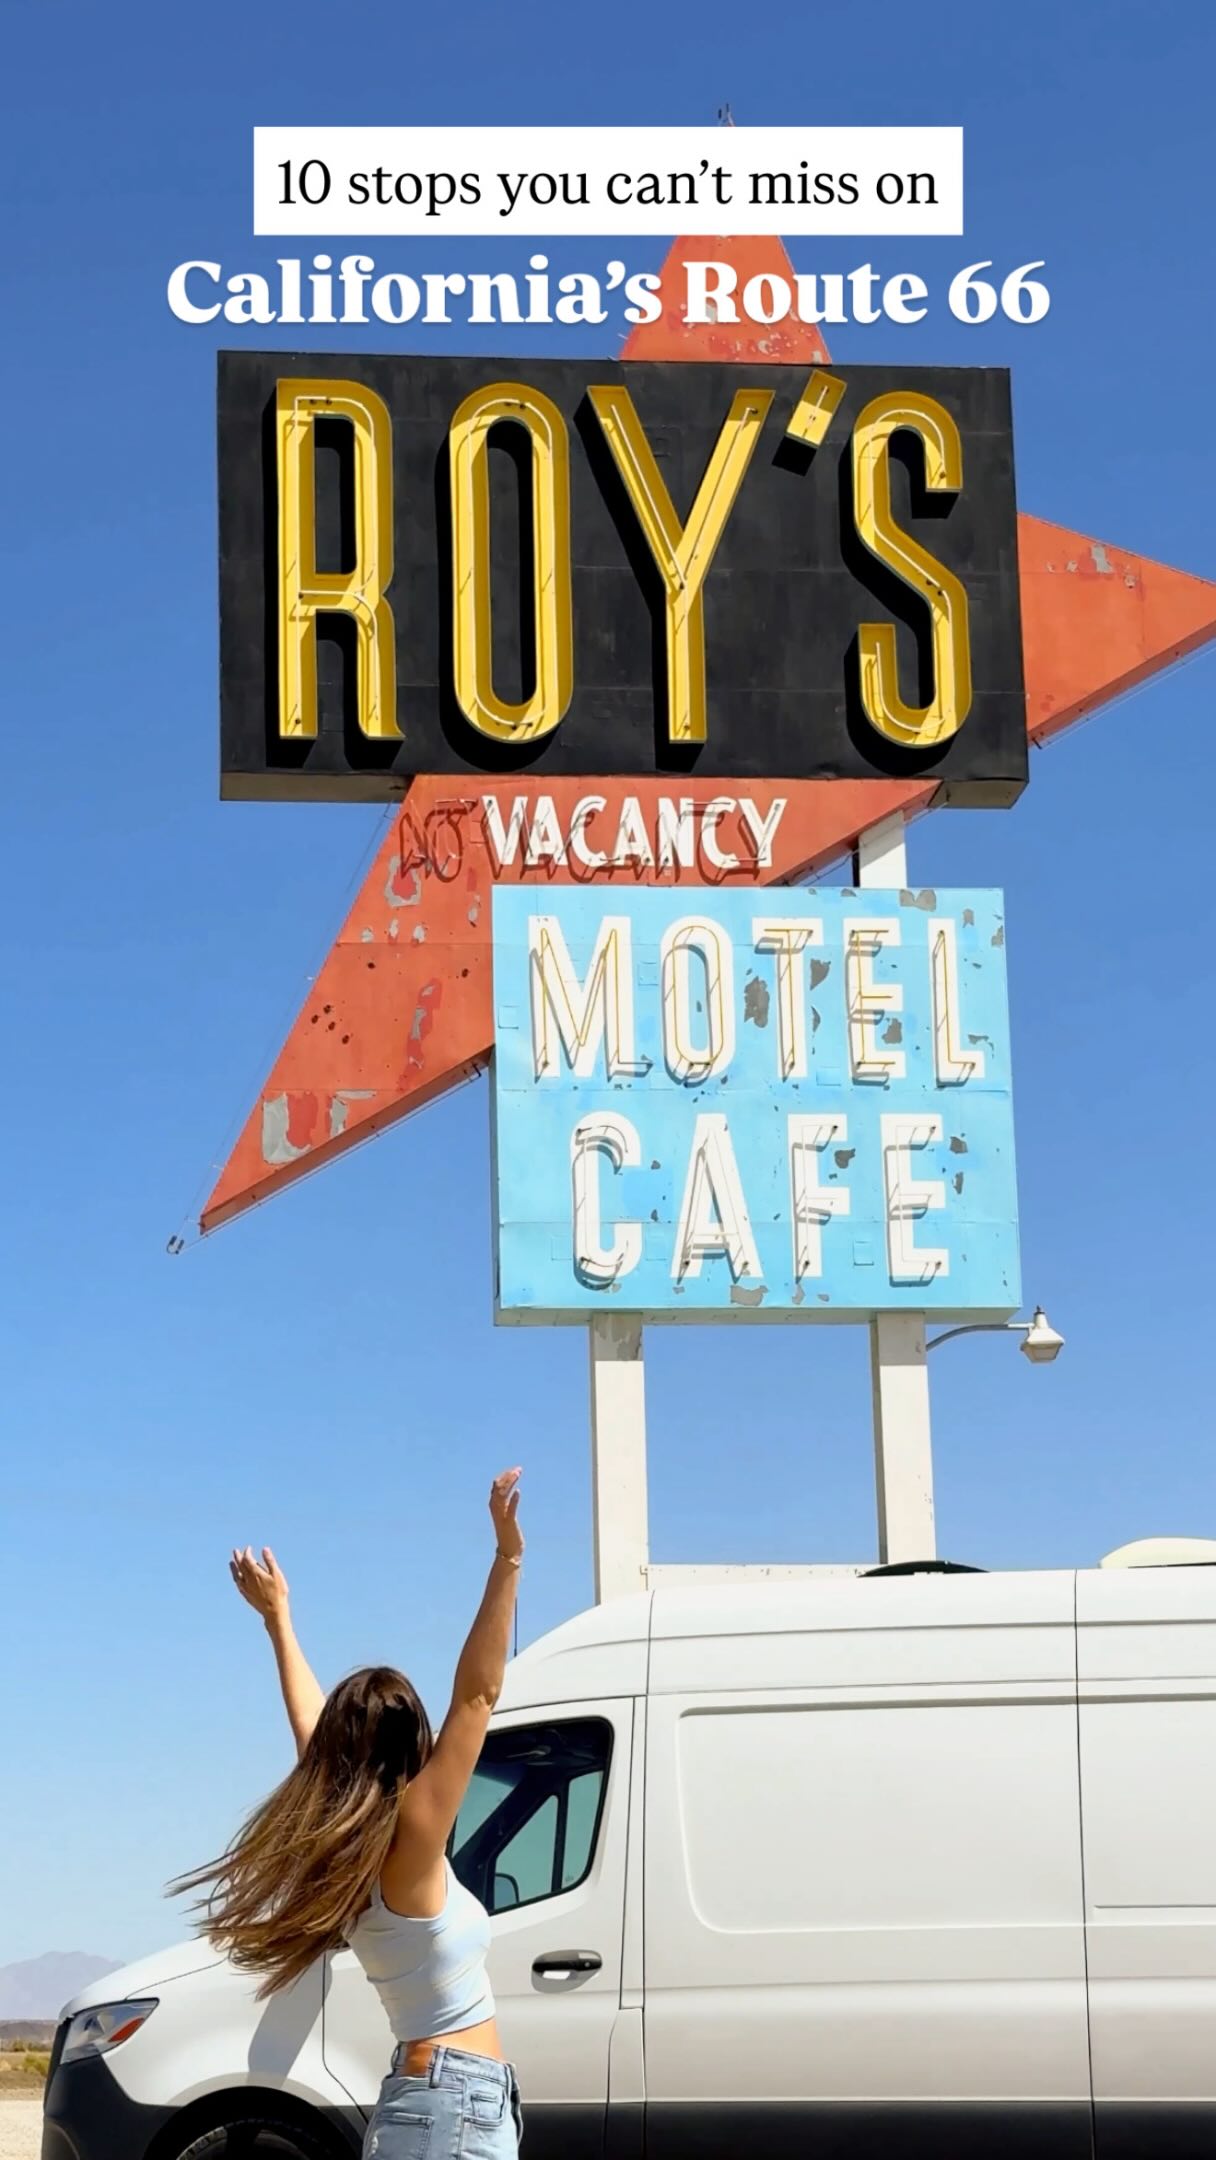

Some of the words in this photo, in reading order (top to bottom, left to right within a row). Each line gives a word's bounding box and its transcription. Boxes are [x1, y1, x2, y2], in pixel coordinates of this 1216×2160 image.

[275, 368, 973, 749] ROY'S
[482, 795, 788, 869] VACANCY
[528, 914, 986, 1080] MOTEL
[570, 1111, 949, 1279] CAFE
